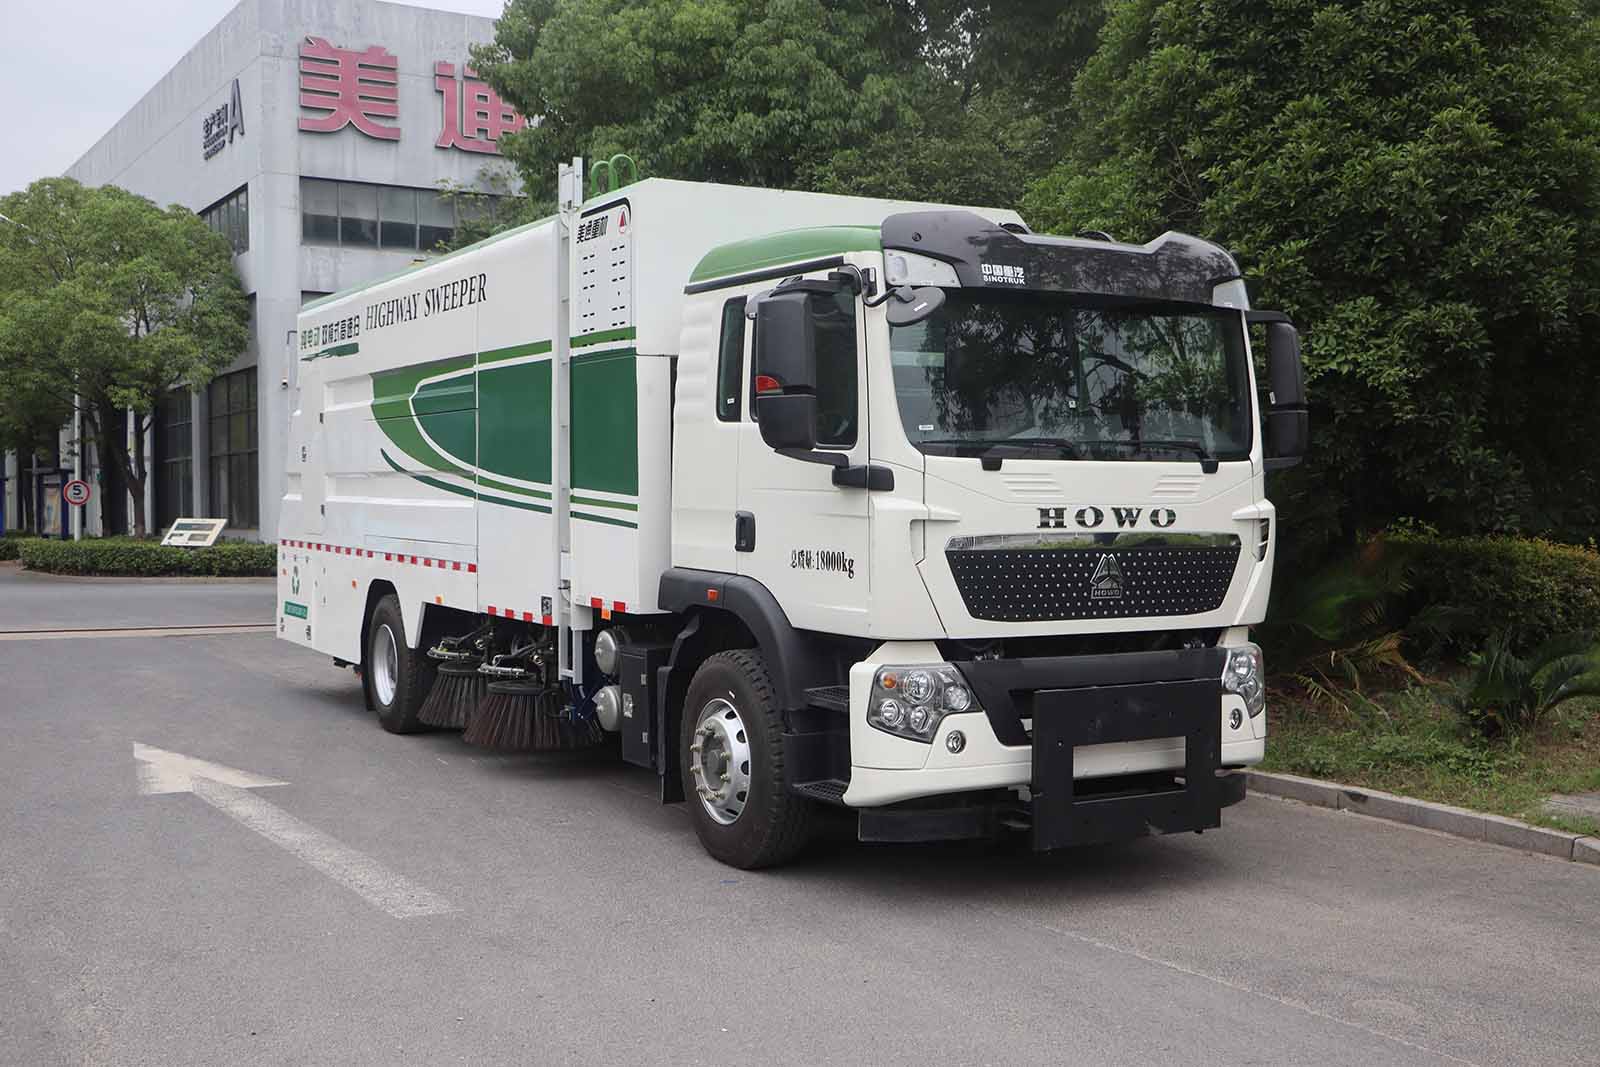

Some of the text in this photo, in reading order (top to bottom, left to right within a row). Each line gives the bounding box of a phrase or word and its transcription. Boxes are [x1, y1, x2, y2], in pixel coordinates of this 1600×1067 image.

[229, 78, 245, 144] A
[983, 275, 1025, 285] SINOTRUK
[365, 272, 487, 331] HIGHWAY SWEEPER
[73, 485, 82, 496] 5
[1036, 506, 1177, 529] HOWO
[1093, 588, 1121, 597] HOWO
